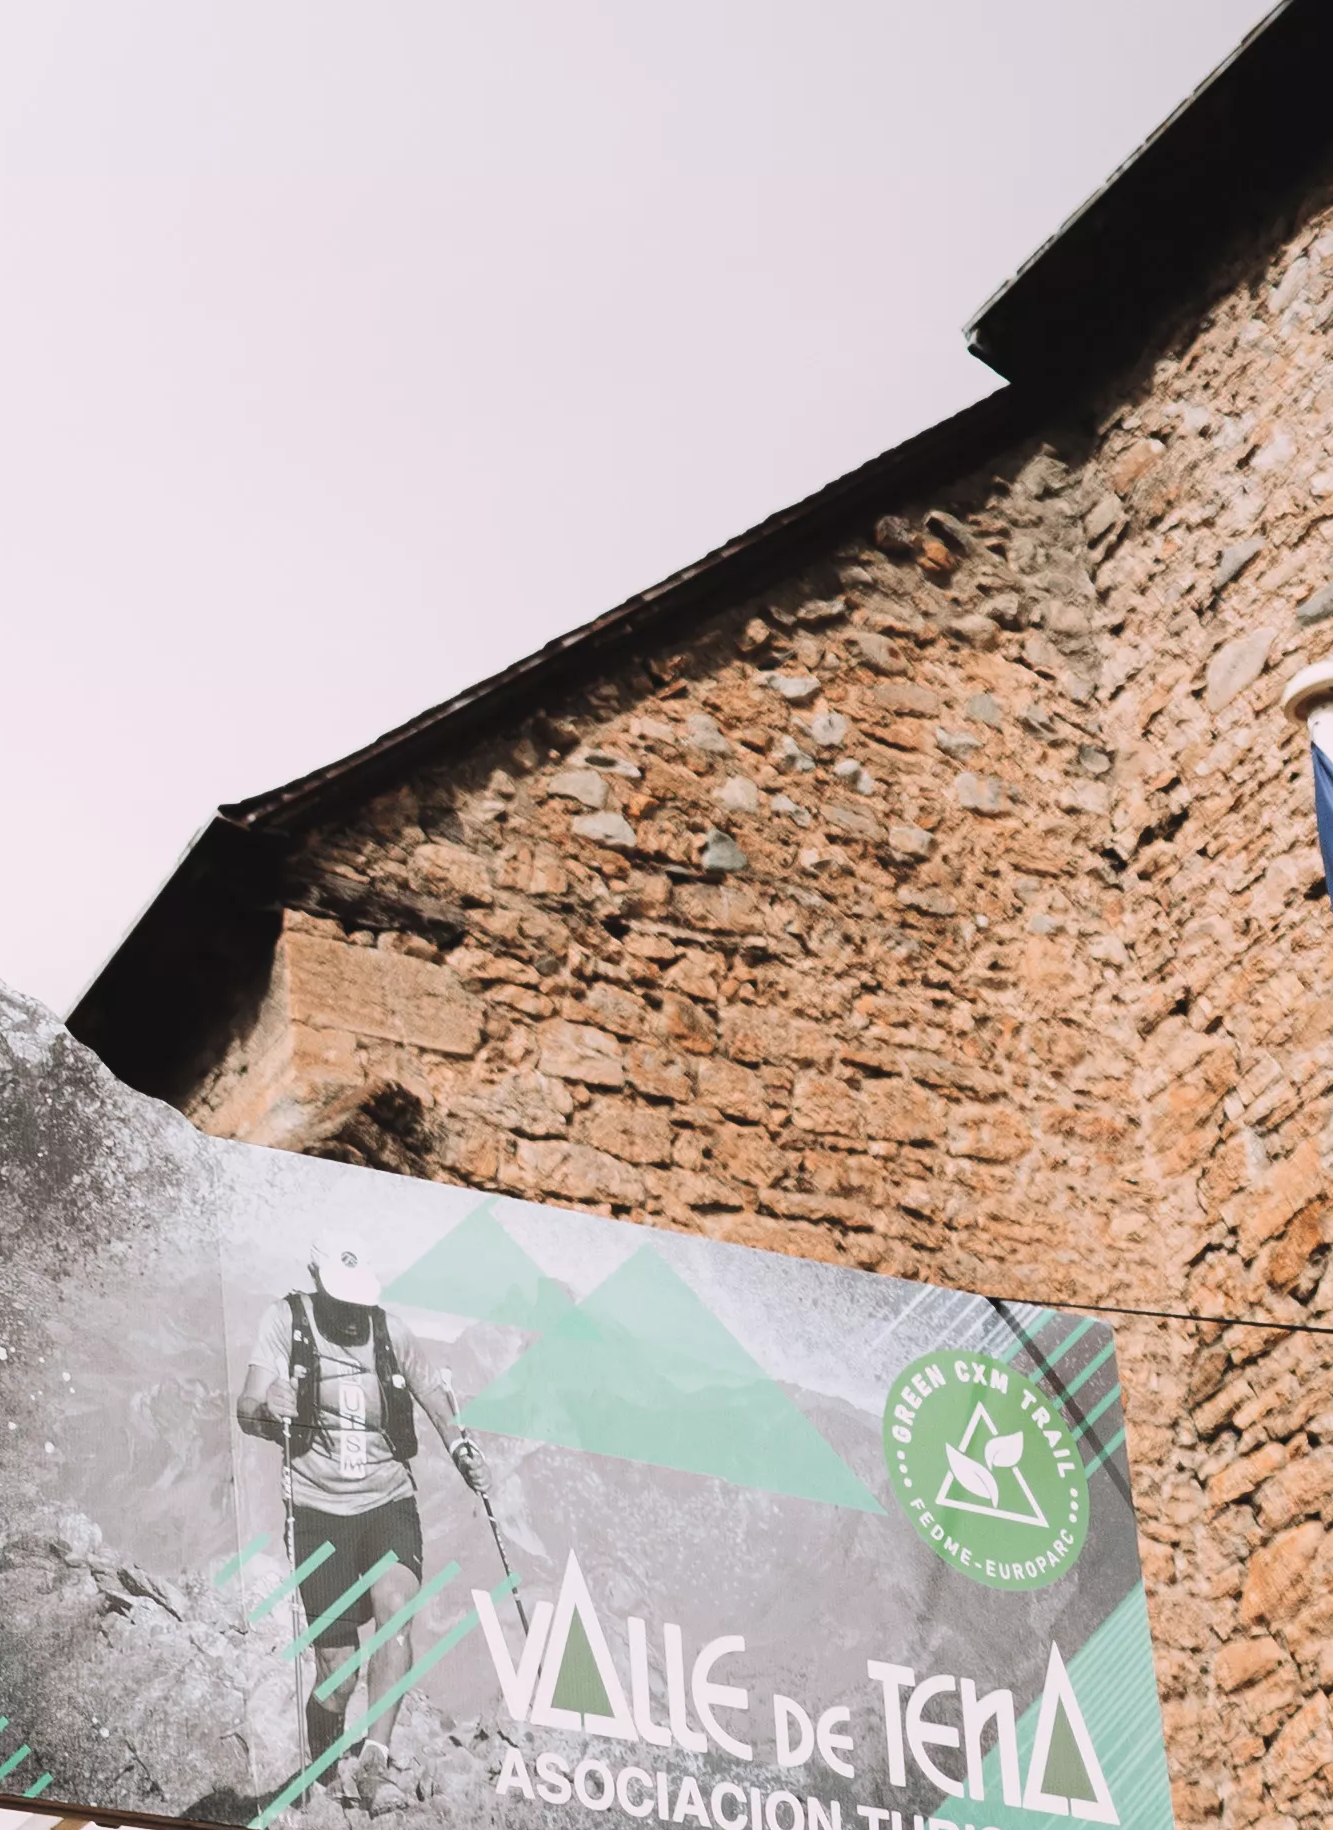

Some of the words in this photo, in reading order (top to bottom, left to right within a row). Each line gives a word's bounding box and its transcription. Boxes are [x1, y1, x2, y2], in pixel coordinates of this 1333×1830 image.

[891, 1363, 947, 1444] GREEN
[954, 1360, 1009, 1395] CXM
[1021, 1389, 1076, 1478] TRAIL
[470, 1548, 753, 1761] VALLE
